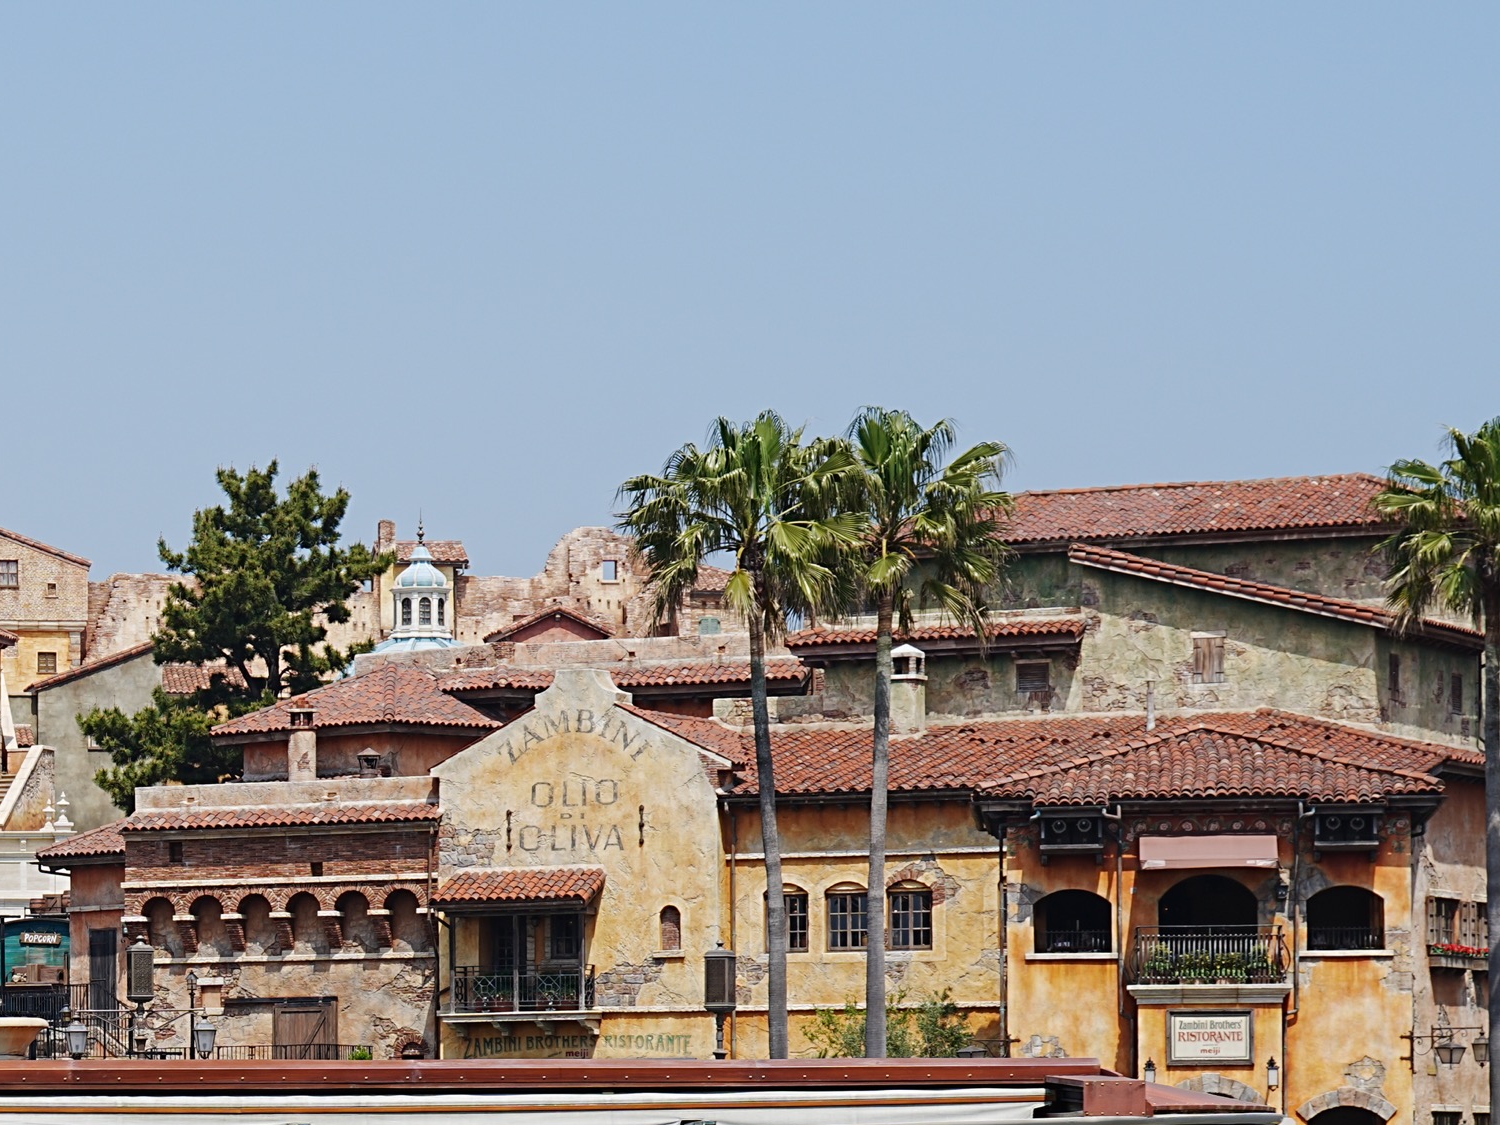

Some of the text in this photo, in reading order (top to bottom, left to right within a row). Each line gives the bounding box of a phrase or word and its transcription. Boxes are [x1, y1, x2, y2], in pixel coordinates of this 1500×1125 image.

[498, 709, 653, 766] ZAMBINI
[531, 779, 619, 808] OLIO
[519, 825, 624, 851] OLIVA
[24, 933, 57, 944] POPCORN
[1179, 1020, 1208, 1030] Zambini
[1178, 1031, 1243, 1043] RISTORANTE
[463, 1034, 693, 1059] ZAMBINI BROTHERS RISTORANTE
[1200, 1047, 1221, 1055] meiji
[565, 1048, 589, 1058] meiji
